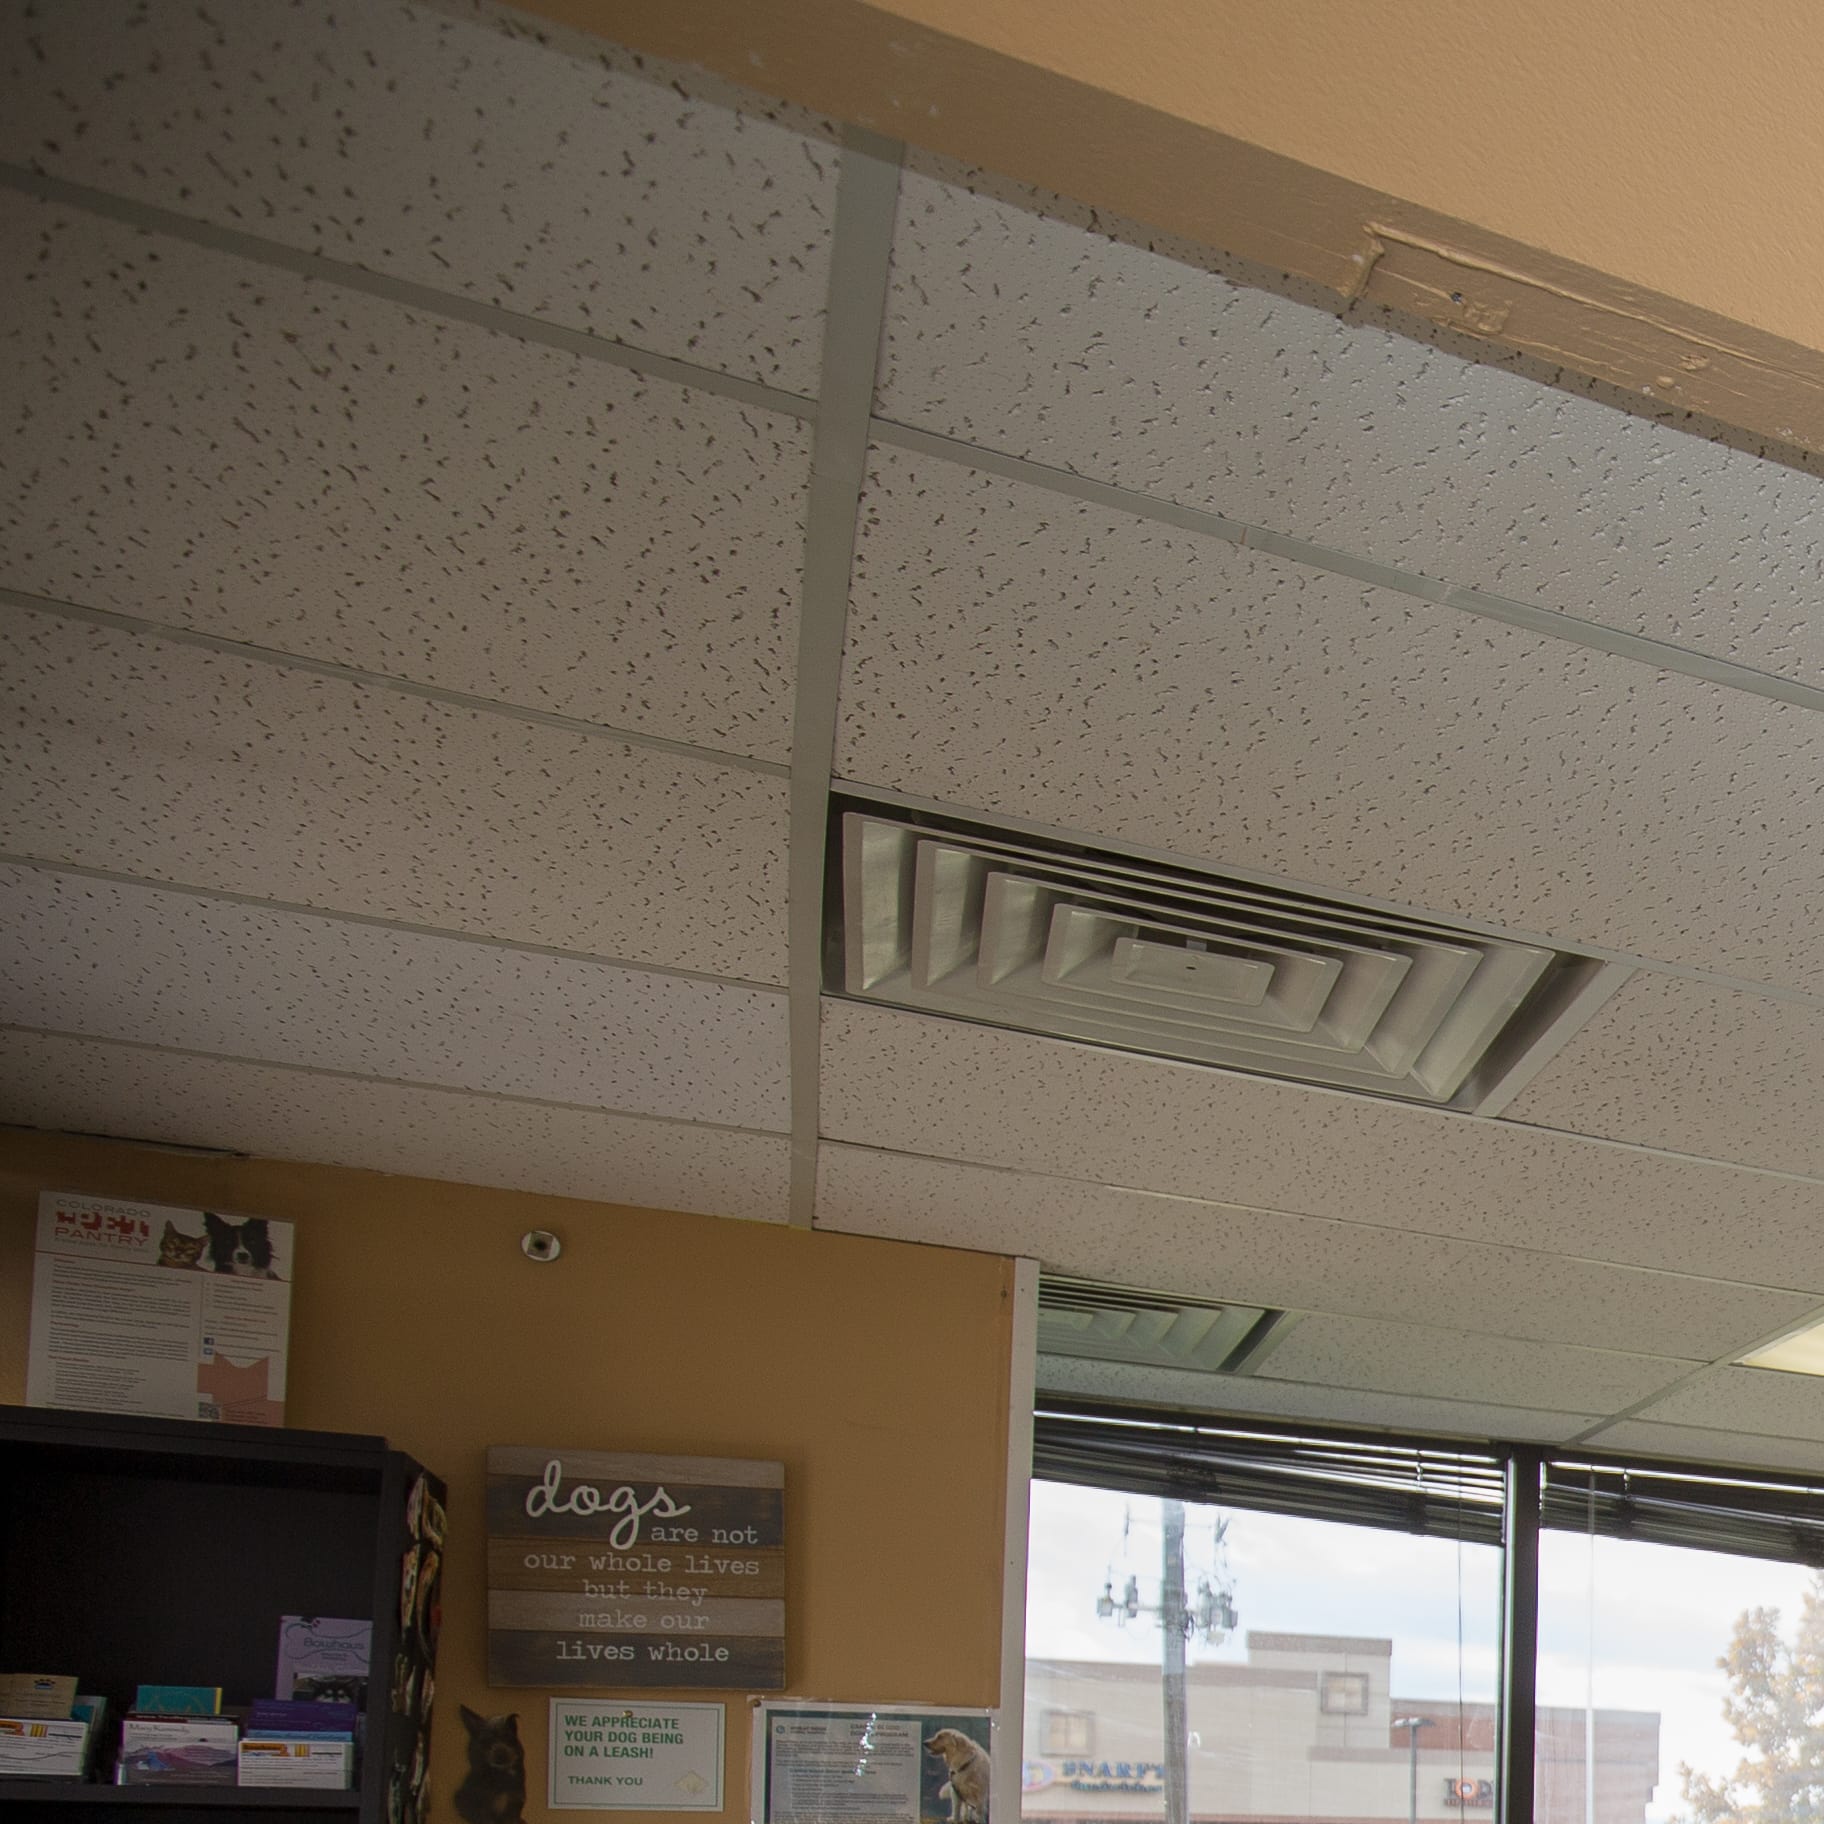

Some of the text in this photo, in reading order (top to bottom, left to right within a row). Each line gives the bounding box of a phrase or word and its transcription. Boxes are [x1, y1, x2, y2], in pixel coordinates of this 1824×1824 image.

[56, 1198, 151, 1217] COLORADO
[54, 1226, 149, 1246] PANTRY
[525, 1460, 692, 1550] dogs
[651, 1525, 759, 1545] are not
[523, 1551, 760, 1576] our whole lives
[582, 1579, 709, 1607] but they
[578, 1609, 711, 1630] make our
[556, 1640, 730, 1663] lives whole
[564, 1714, 680, 1730] WE APPRECIATE
[564, 1730, 685, 1745] YOUR DOG BEING
[564, 1745, 654, 1759] ON A LEASH!
[567, 1776, 644, 1786] THANK YOU
